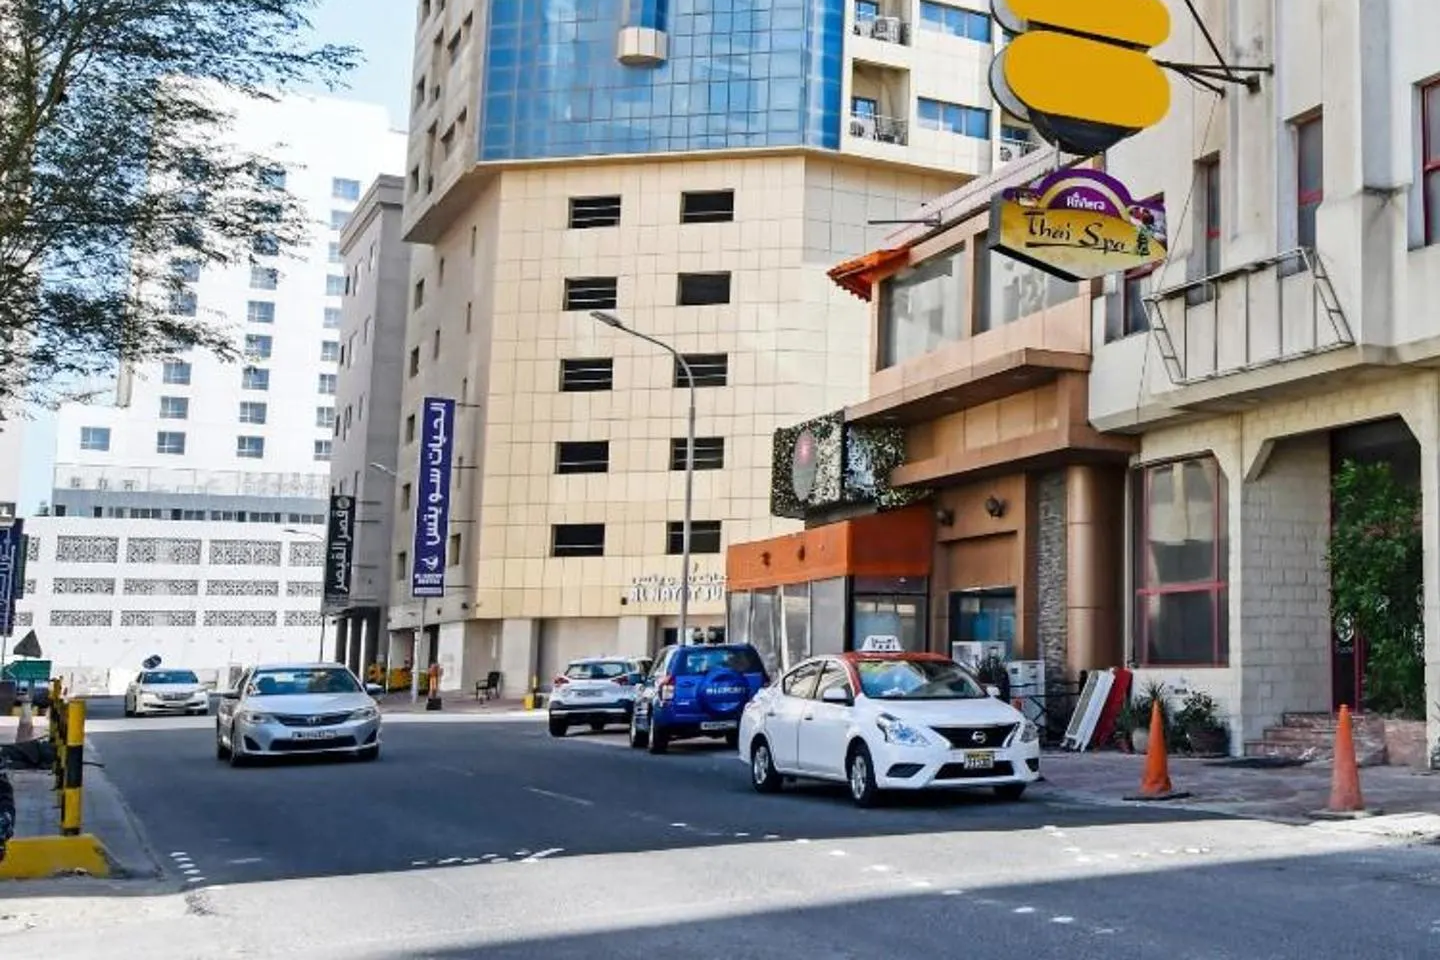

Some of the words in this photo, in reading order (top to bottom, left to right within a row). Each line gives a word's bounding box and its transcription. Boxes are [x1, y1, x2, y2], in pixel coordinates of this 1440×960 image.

[1066, 194, 1106, 210] Riviera
[1023, 211, 1070, 242] Thai
[1078, 222, 1126, 255] Spa
